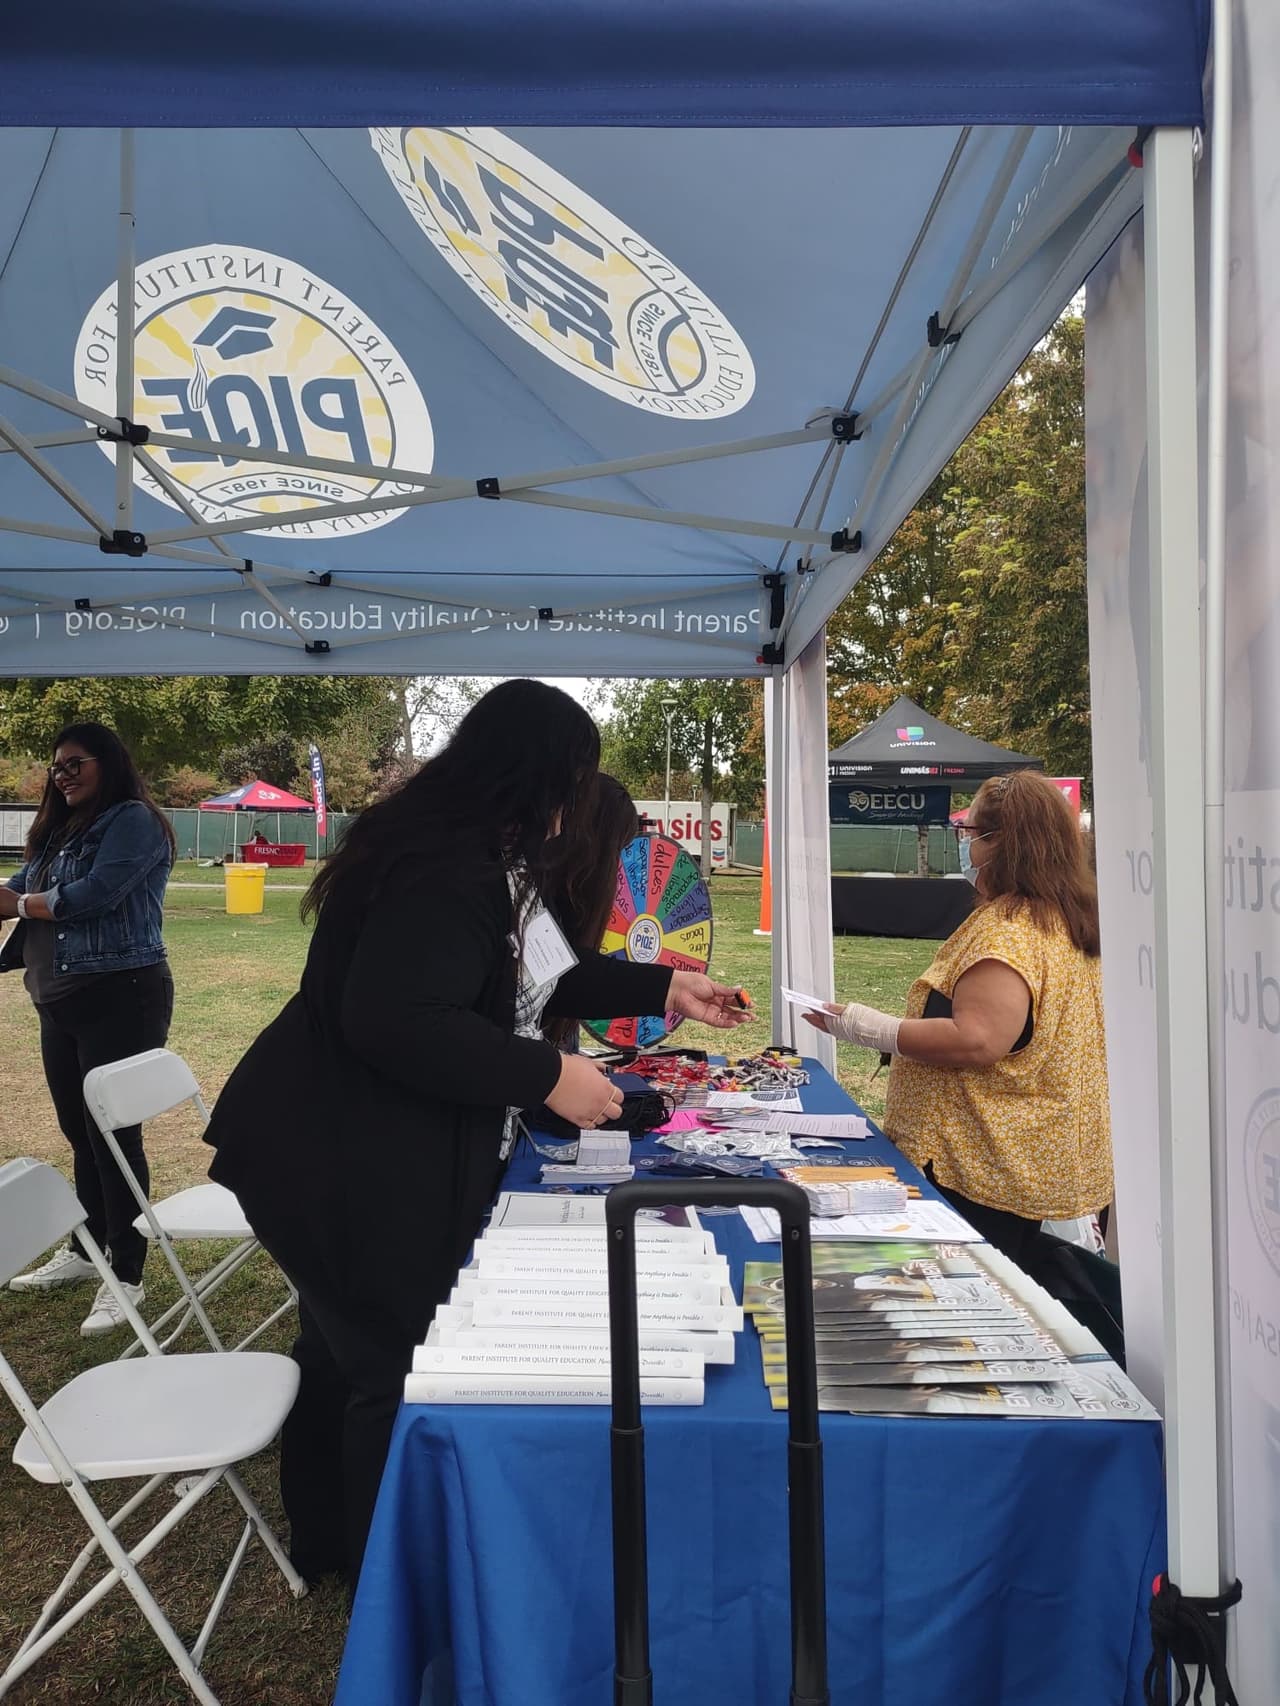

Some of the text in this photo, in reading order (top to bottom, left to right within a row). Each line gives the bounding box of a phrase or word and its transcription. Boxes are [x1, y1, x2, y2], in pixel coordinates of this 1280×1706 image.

[871, 793, 926, 810] EECU
[652, 843, 673, 895] dulces
[635, 934, 654, 950] PIQE
[486, 1355, 518, 1363] INSTITUTE
[532, 1356, 560, 1364] QUALITY
[480, 1390, 515, 1398] INSTITUTE
[516, 1390, 527, 1398] FOR
[527, 1390, 557, 1398] QUALITY
[556, 1390, 595, 1398] EDUCATION
